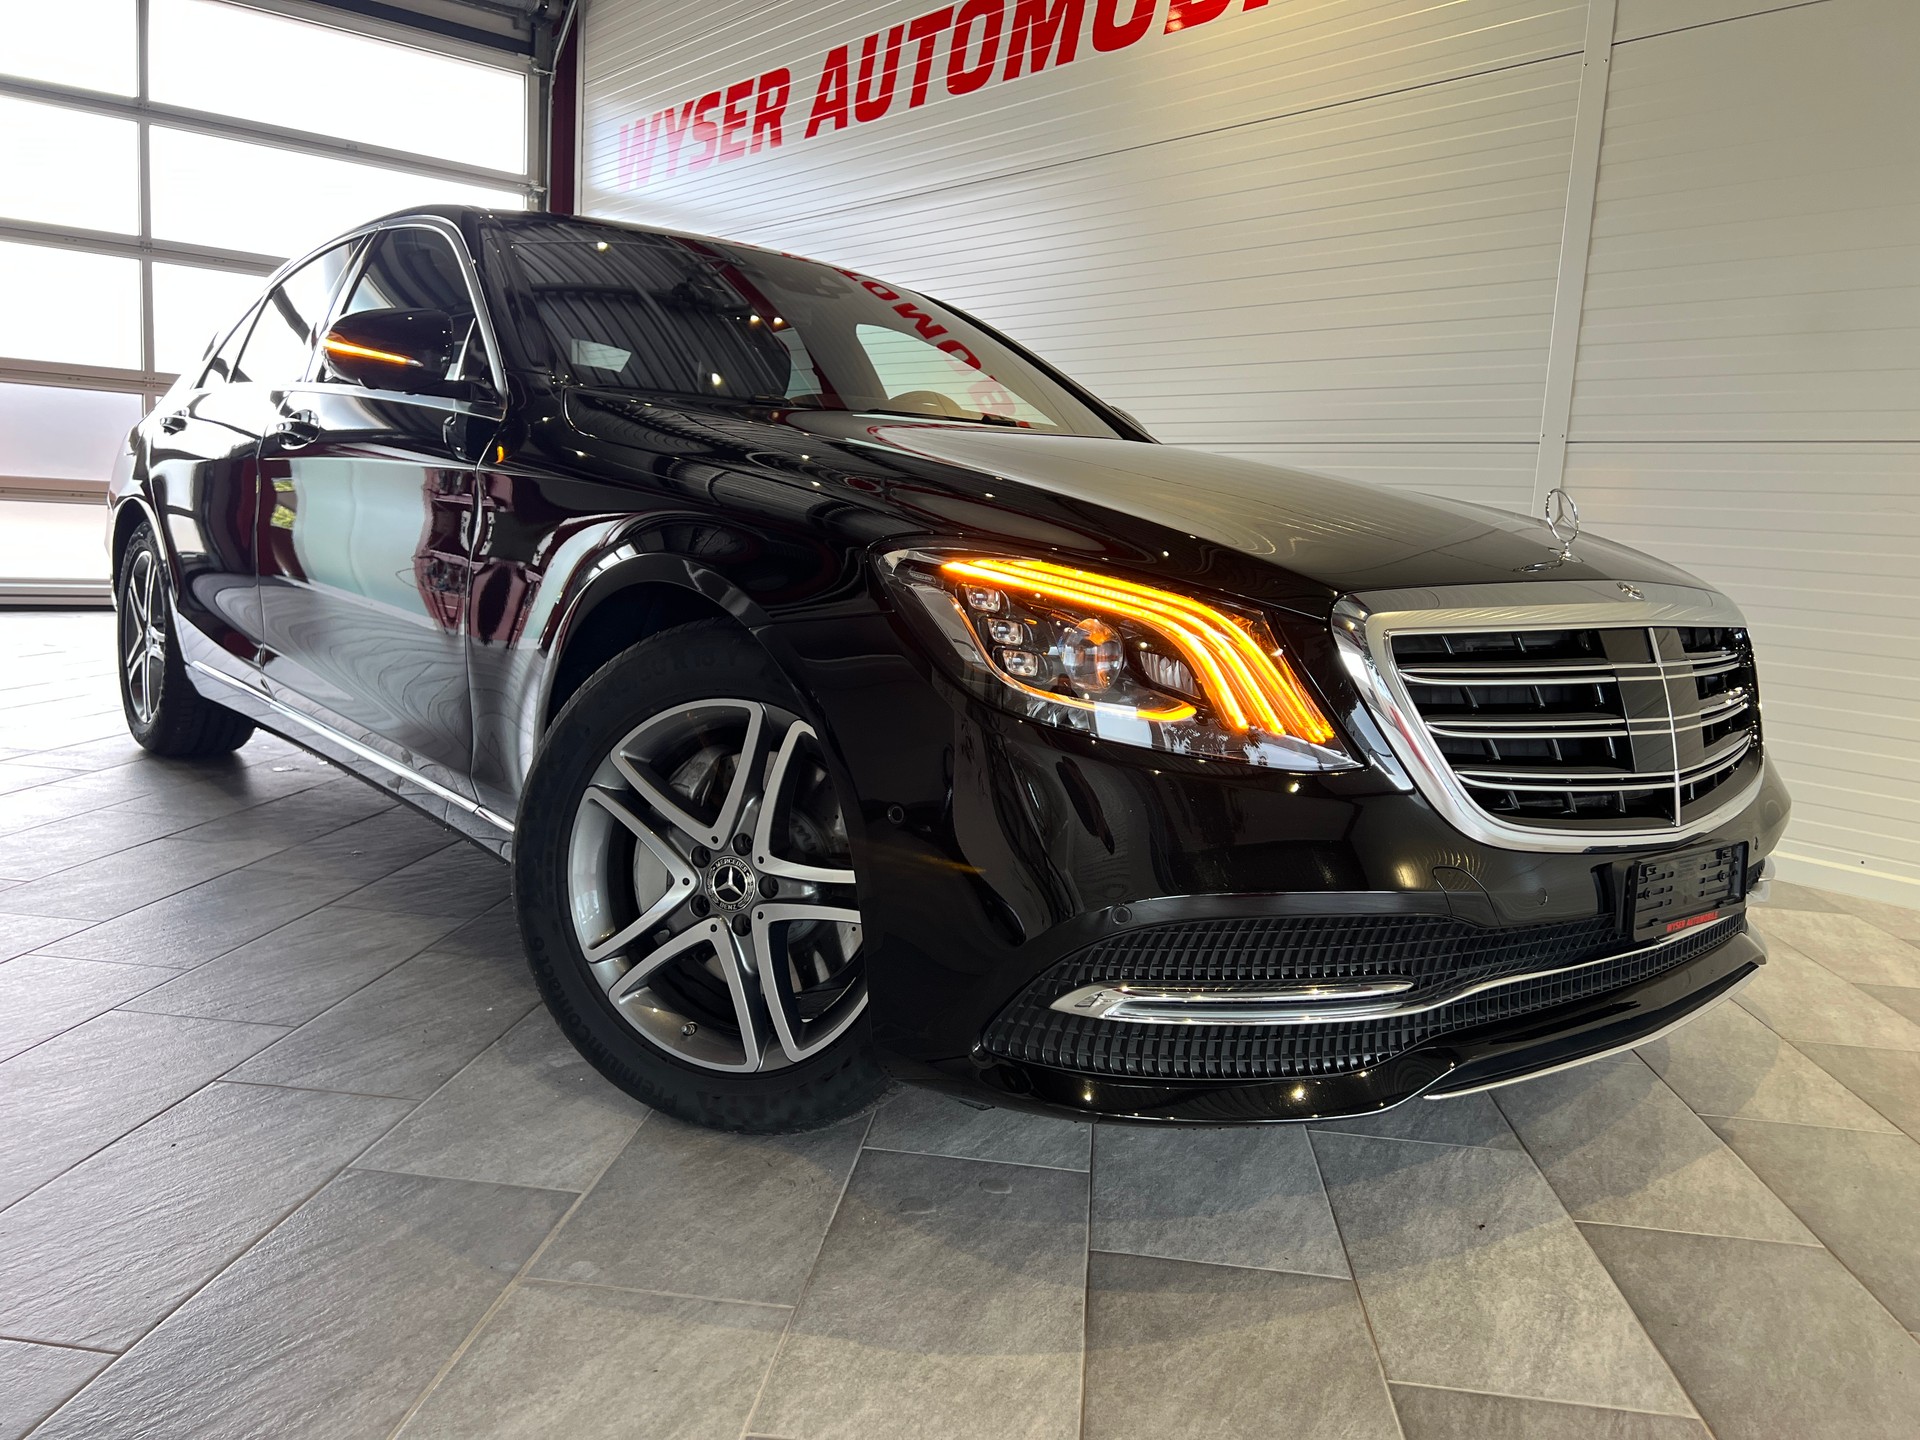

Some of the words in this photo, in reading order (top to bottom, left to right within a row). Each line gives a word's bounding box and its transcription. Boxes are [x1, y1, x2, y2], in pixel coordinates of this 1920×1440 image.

[617, 67, 791, 192] WYSER
[804, 0, 1269, 138] AUTOM
[714, 858, 748, 873] MERCEDES
[719, 902, 738, 911] BENZ
[1666, 919, 1686, 933] WYSER
